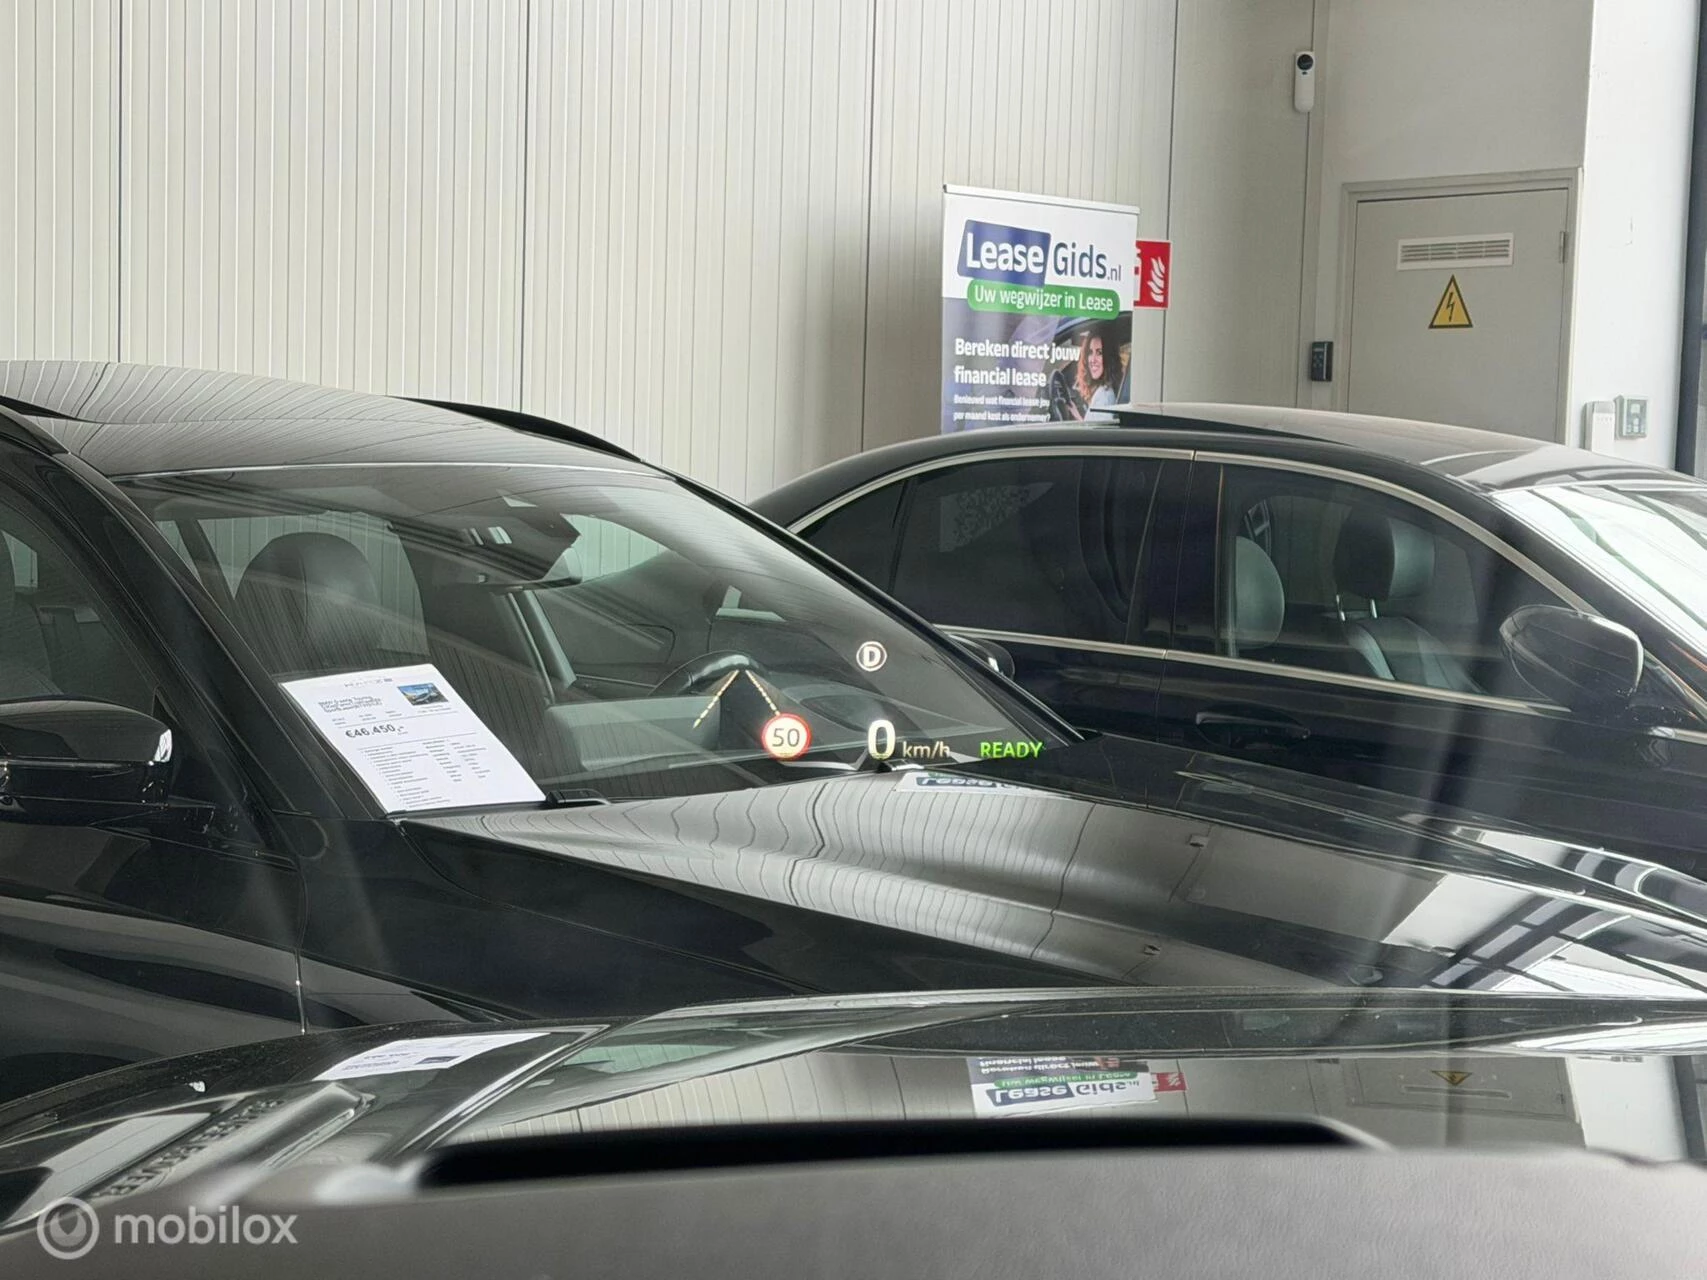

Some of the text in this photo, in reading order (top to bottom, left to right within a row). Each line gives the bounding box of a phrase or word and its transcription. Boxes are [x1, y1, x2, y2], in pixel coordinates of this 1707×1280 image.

[974, 285, 1113, 312] Uw wegwijzer in Lease
[955, 338, 1081, 364] Bereken direct jouw
[954, 366, 1047, 388] financial lease
[865, 647, 880, 666] D
[772, 727, 801, 748] 50
[867, 719, 950, 760] 0 km/h
[980, 741, 1043, 758] READY
